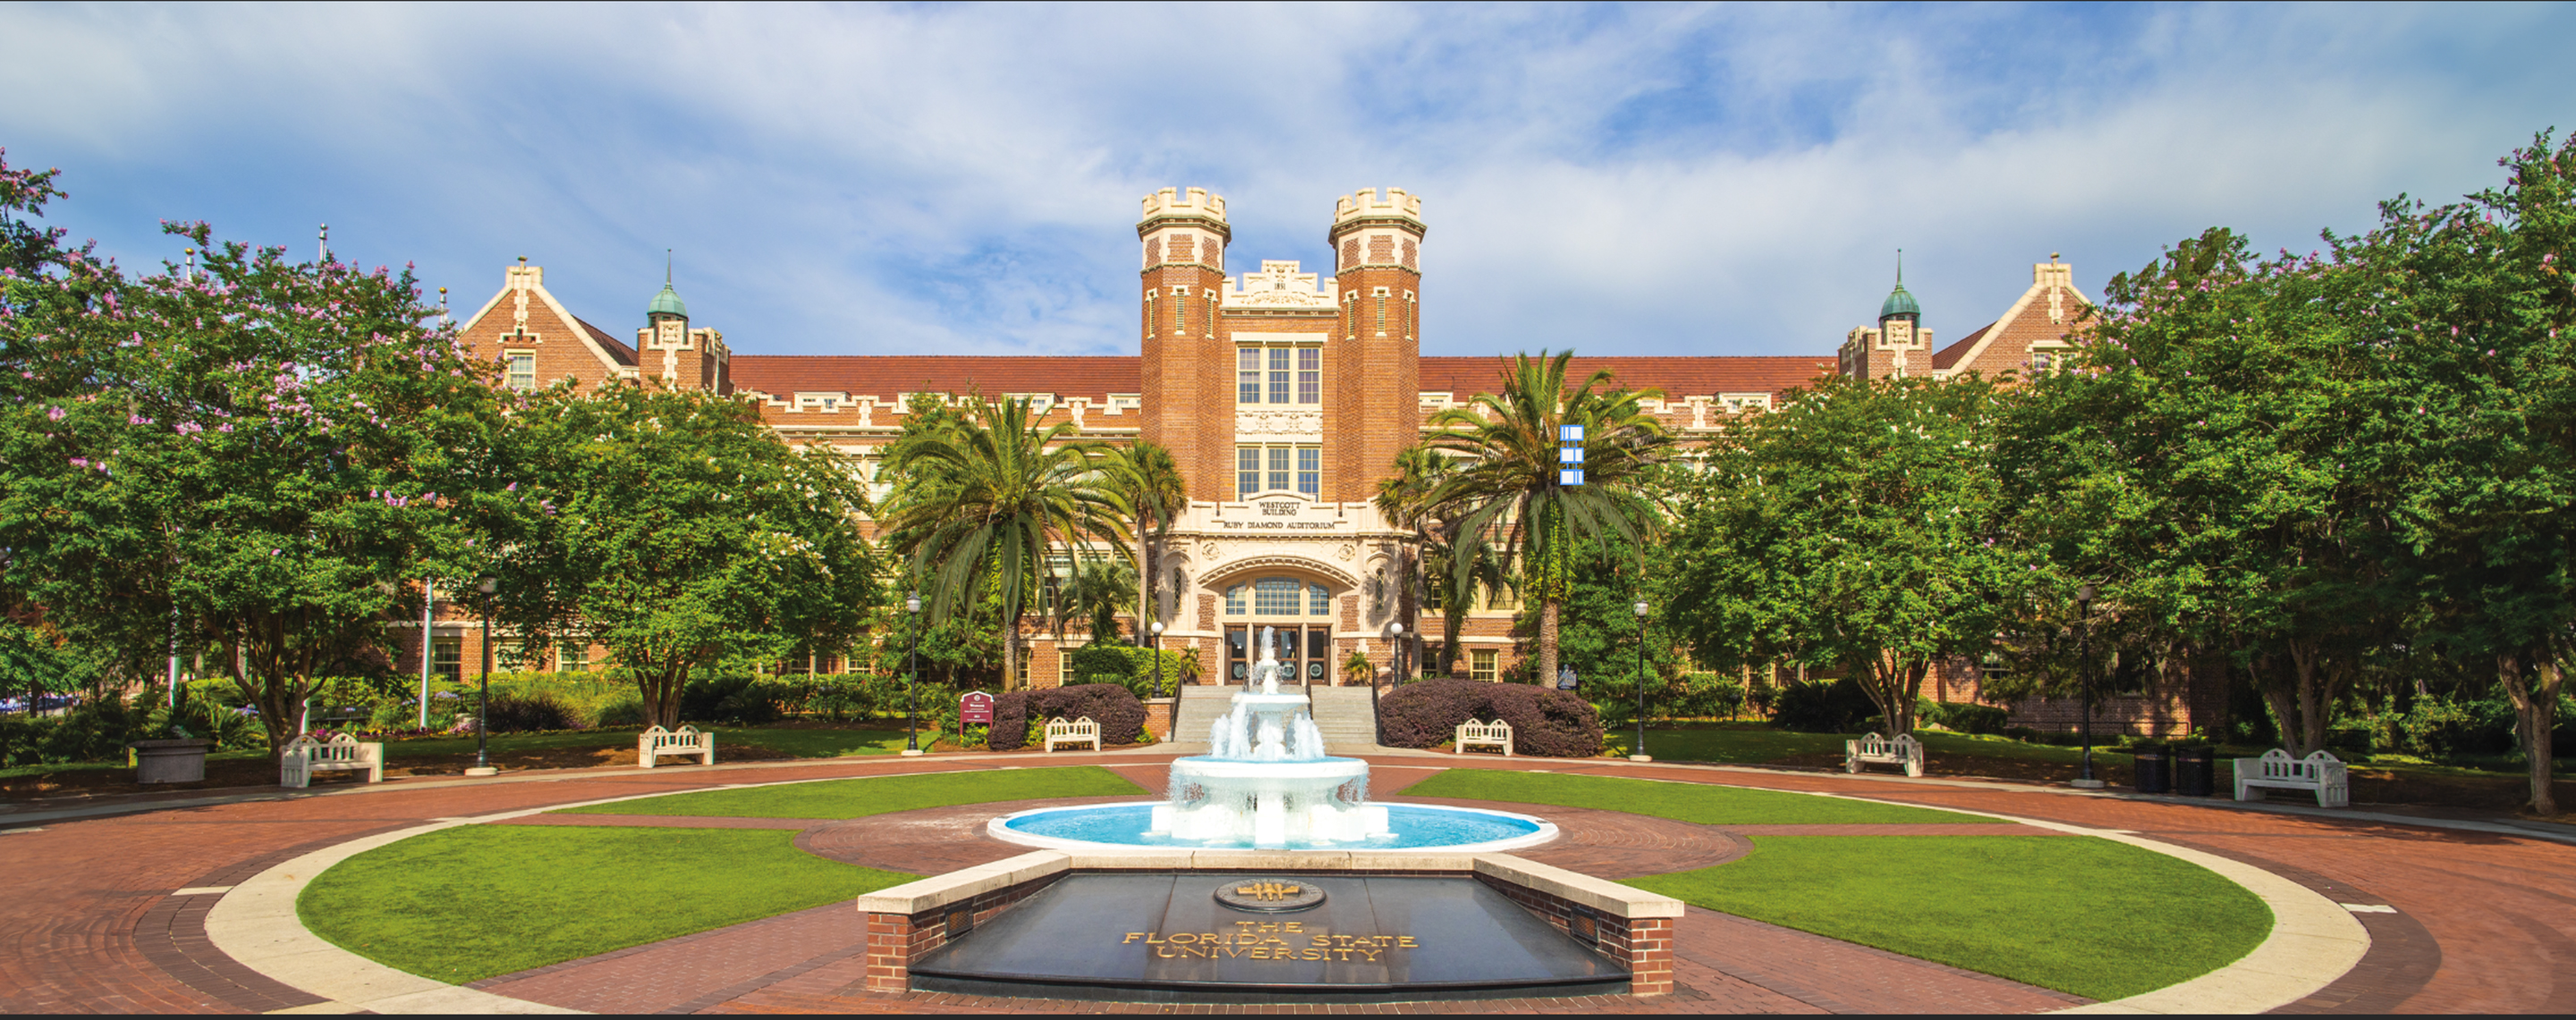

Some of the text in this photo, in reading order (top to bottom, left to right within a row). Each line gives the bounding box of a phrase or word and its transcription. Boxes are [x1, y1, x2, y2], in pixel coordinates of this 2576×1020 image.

[1258, 501, 1301, 509] WESTCOTT
[1286, 522, 1335, 530] AUDITORIUM
[1235, 922, 1304, 933] THE
[1122, 932, 1419, 948] FLORIDA STATE
[1157, 945, 1383, 962] UNIVERSITY
